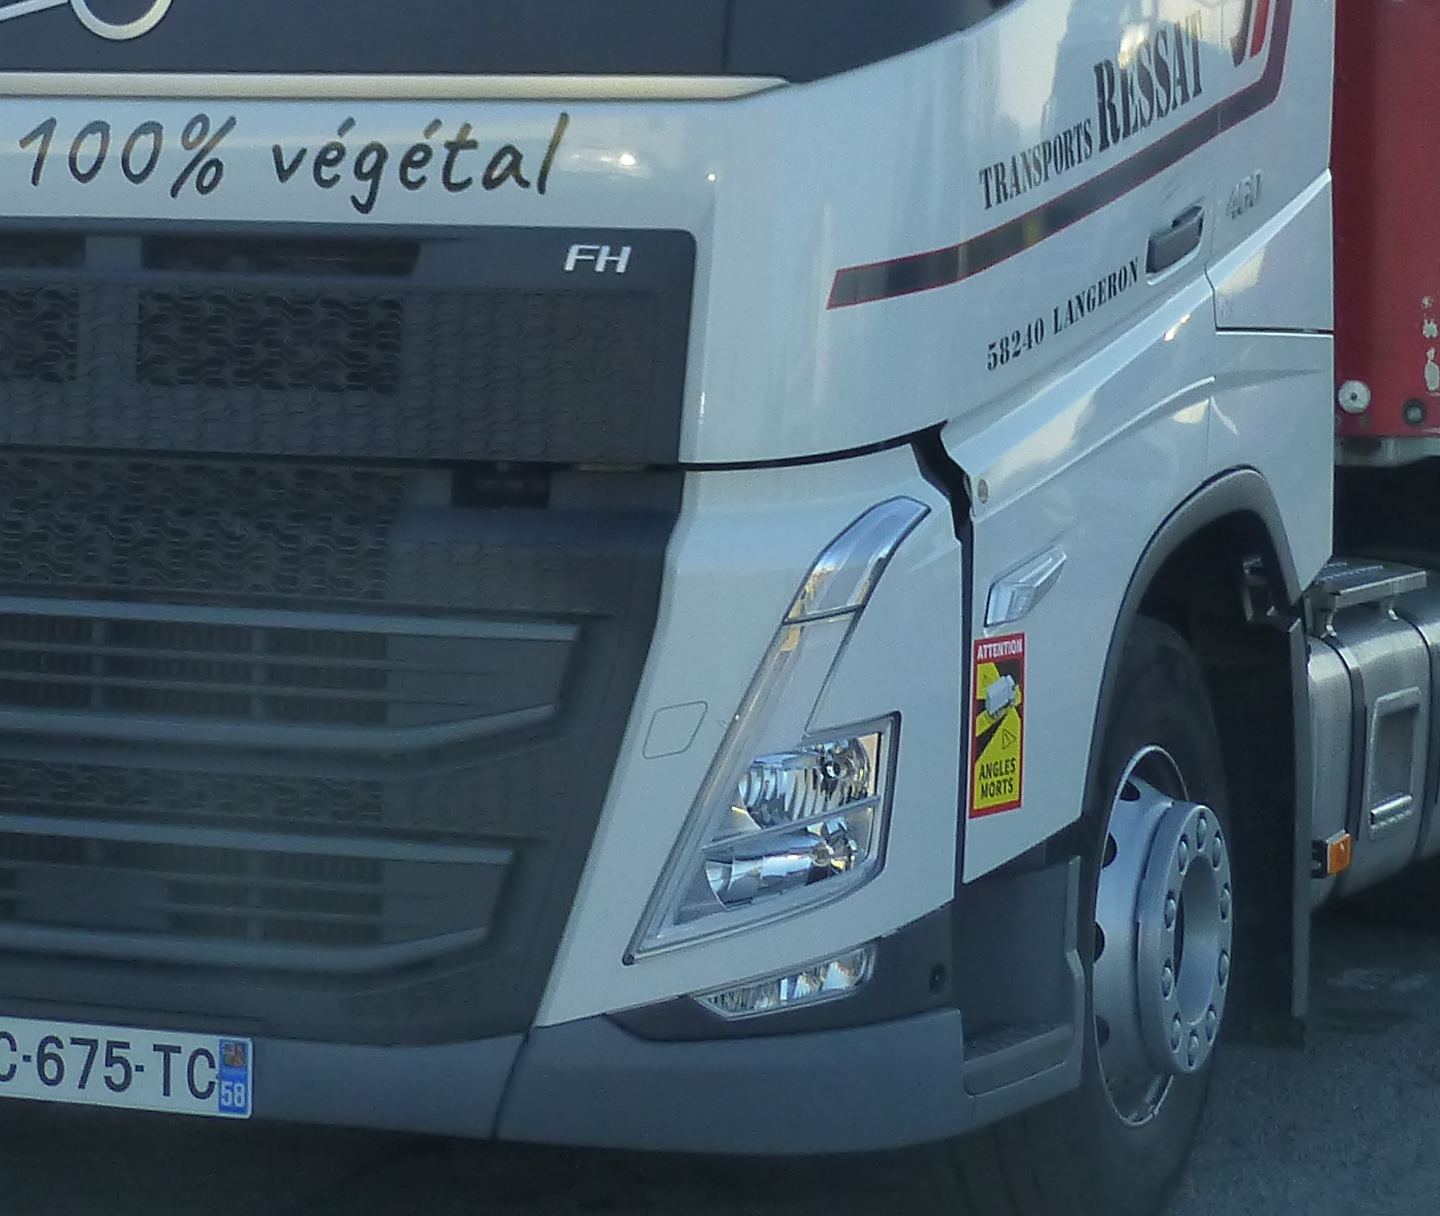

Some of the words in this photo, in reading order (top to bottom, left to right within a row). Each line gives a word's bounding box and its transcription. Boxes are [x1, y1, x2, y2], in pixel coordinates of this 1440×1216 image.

[979, 118, 1093, 210] TRANSPORTS
[1093, 10, 1203, 151] RESSAT
[18, 112, 238, 199] 100%
[271, 110, 572, 214] végétal
[563, 243, 633, 275] FH
[986, 318, 1045, 372] 58240
[1053, 258, 1140, 334] LANGERON
[976, 638, 1023, 660] ATTENTION
[978, 757, 1016, 781] ANGLES
[979, 777, 1014, 800] MORTS
[221, 1081, 247, 1108] 58
